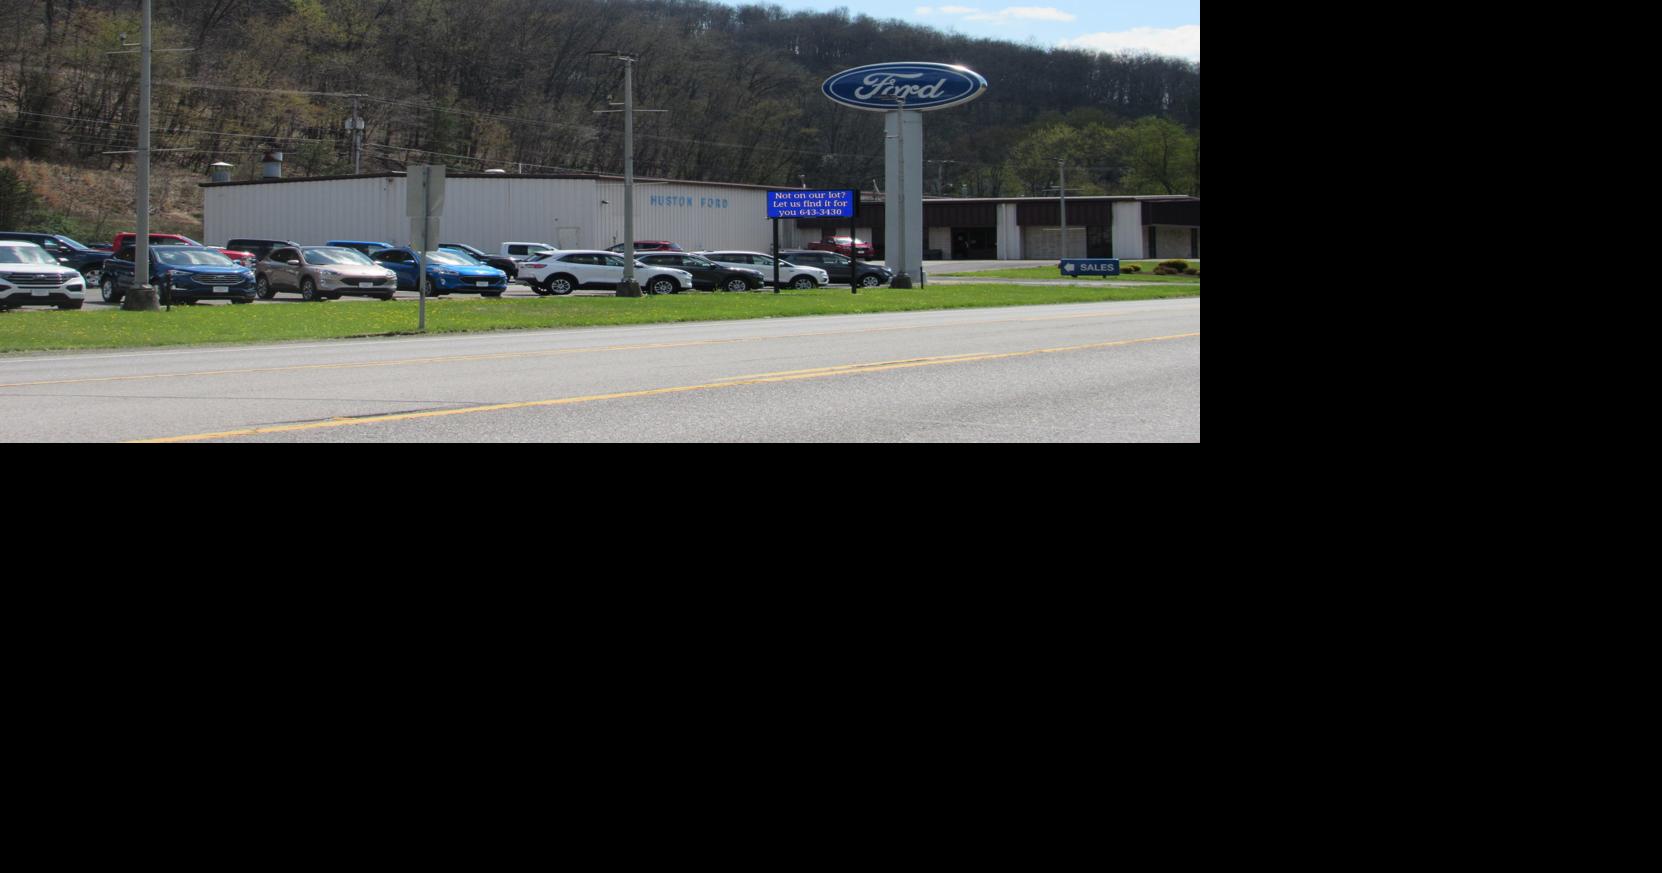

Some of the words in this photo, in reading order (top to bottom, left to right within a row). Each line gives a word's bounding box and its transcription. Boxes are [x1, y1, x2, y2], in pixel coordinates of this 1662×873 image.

[854, 72, 947, 100] Ford
[828, 191, 846, 199] lot?
[650, 195, 692, 207] HUSTON
[700, 197, 728, 209] FORD
[773, 200, 788, 208] Let
[803, 199, 821, 207] find
[824, 199, 831, 207] it
[833, 199, 848, 207] for
[778, 209, 797, 217] you
[799, 208, 842, 216] 643-3430
[1080, 263, 1114, 271] SALES
